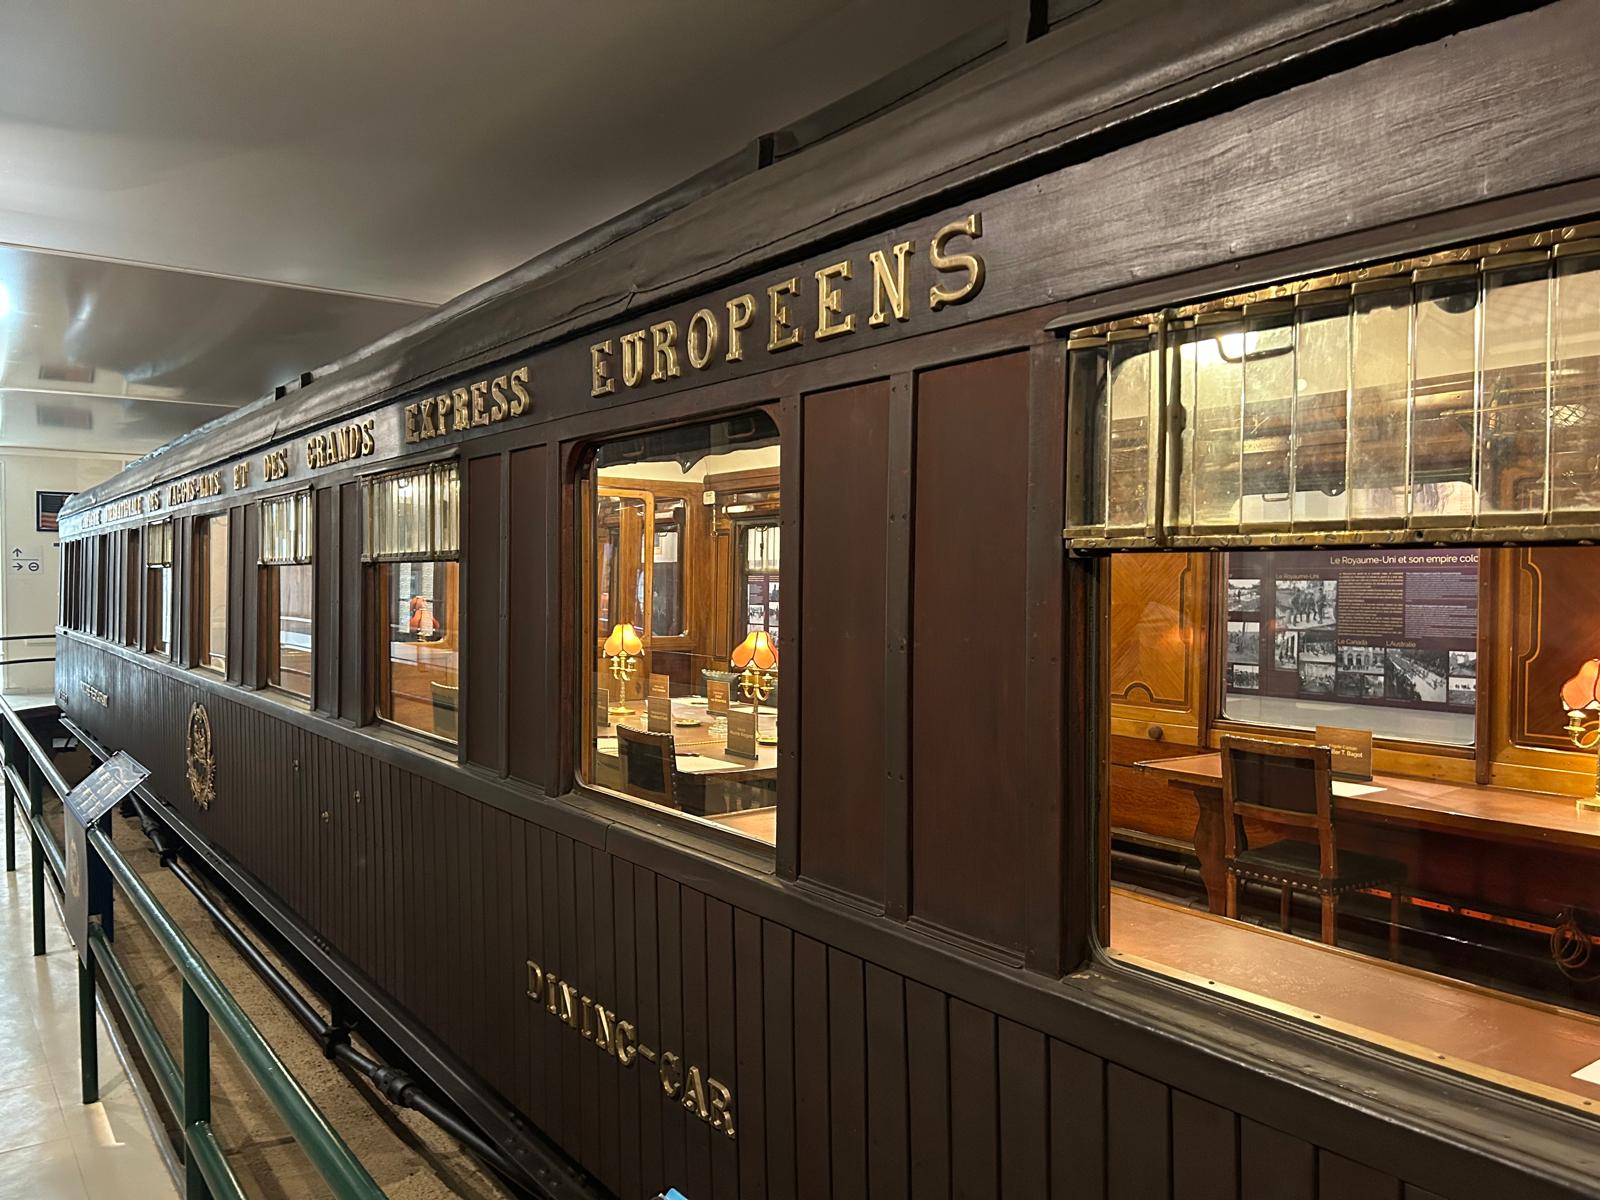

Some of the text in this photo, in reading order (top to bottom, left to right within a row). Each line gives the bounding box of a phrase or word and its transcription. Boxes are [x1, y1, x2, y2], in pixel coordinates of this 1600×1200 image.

[233, 460, 250, 490] ET
[263, 447, 289, 482] DES
[306, 418, 375, 470] GRANDS
[403, 366, 532, 444] EXPRESS
[590, 212, 985, 397] EUROPEENS
[1330, 555, 1341, 565] Le
[1341, 555, 1397, 566] Royaume-Uni
[1398, 555, 1407, 564] et
[1408, 556, 1425, 564] son
[1426, 554, 1457, 567] empire
[526, 959, 736, 1139] DINING-CAR
